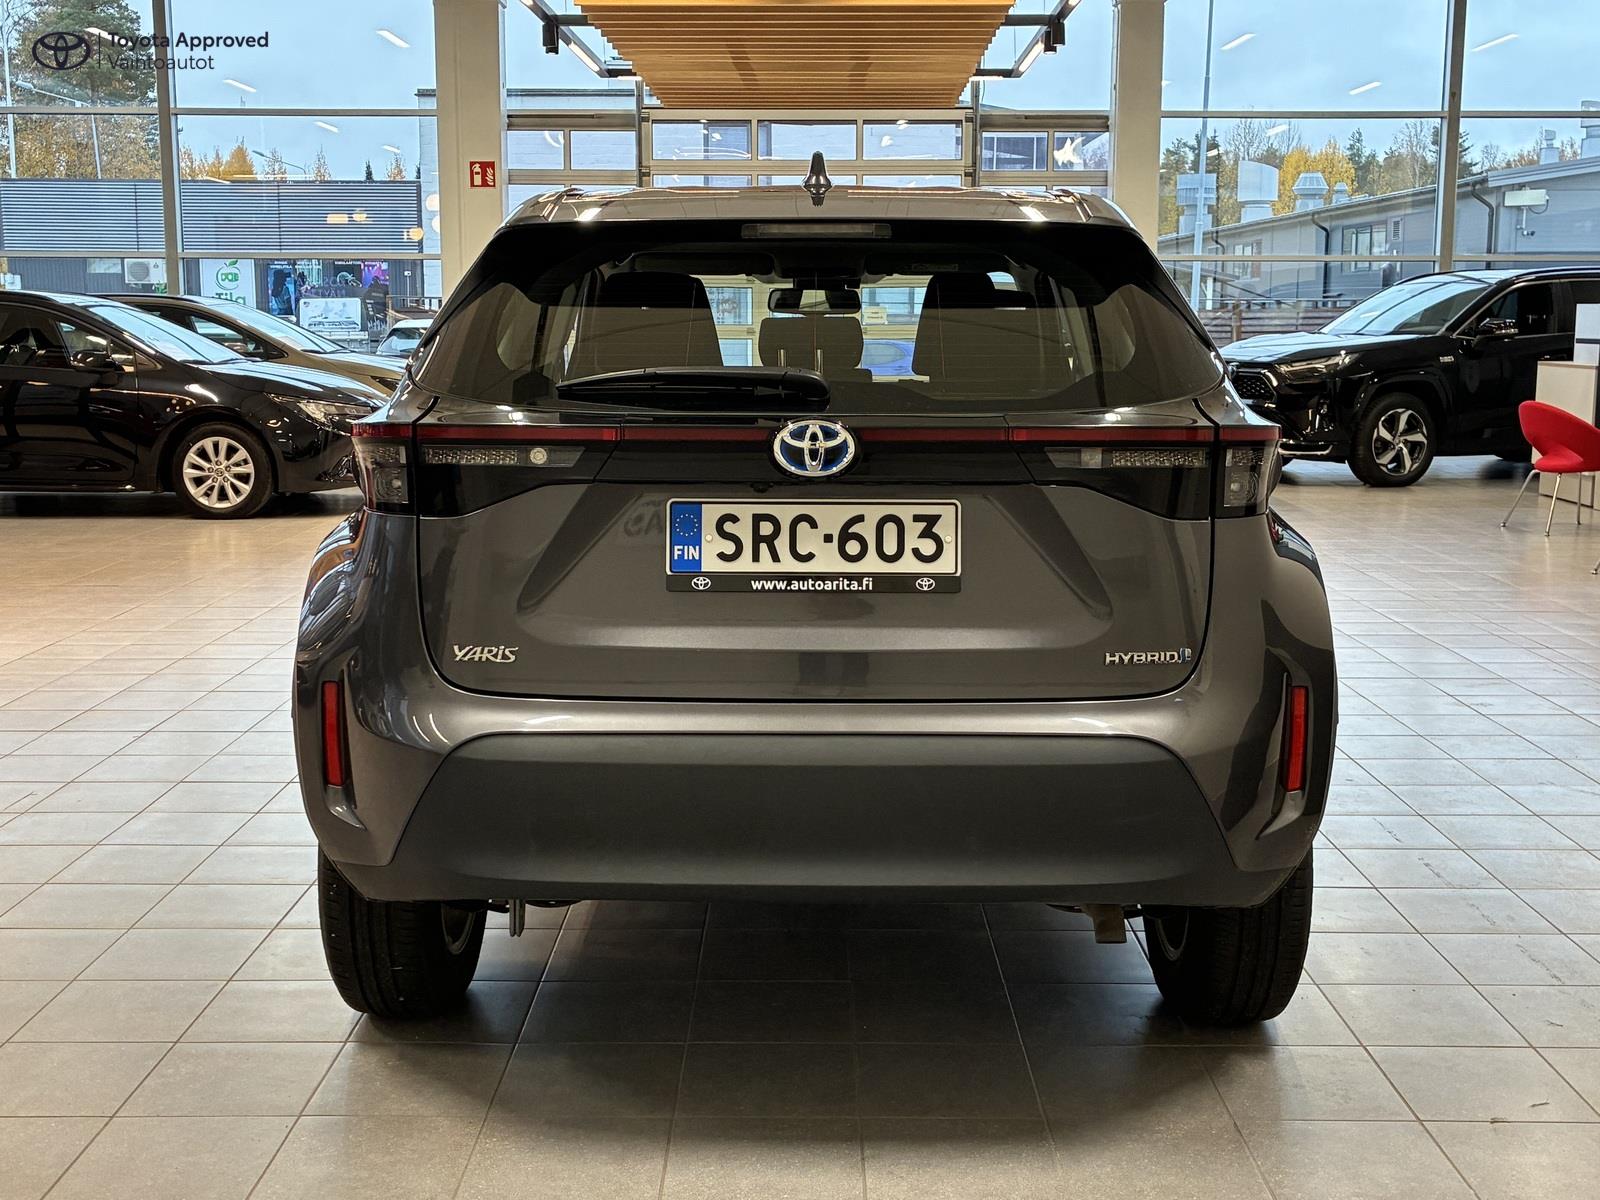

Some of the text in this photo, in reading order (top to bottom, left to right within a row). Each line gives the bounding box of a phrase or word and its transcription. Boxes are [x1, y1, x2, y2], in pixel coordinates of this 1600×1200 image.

[715, 513, 945, 563] SRC-603
[674, 545, 700, 560] FIN
[751, 577, 873, 591] www.autoarita.fi
[1105, 651, 1179, 665] HYBRID
